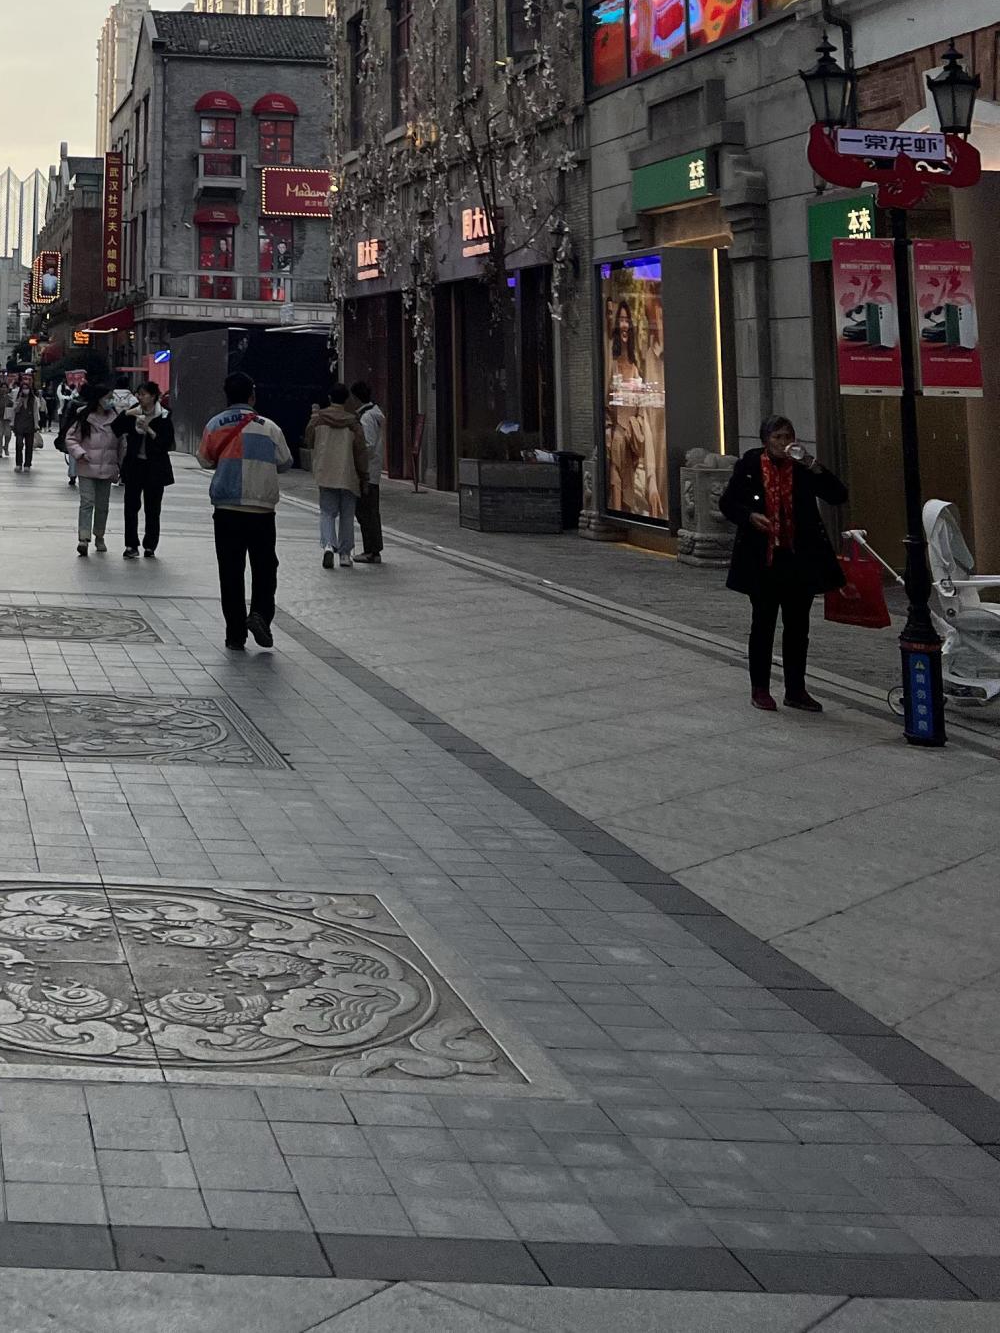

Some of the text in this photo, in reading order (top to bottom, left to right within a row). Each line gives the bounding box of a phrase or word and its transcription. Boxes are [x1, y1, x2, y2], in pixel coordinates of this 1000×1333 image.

[106, 167, 120, 287] 武汉杜莎夫人蜡像馆
[847, 207, 872, 233] 本来
